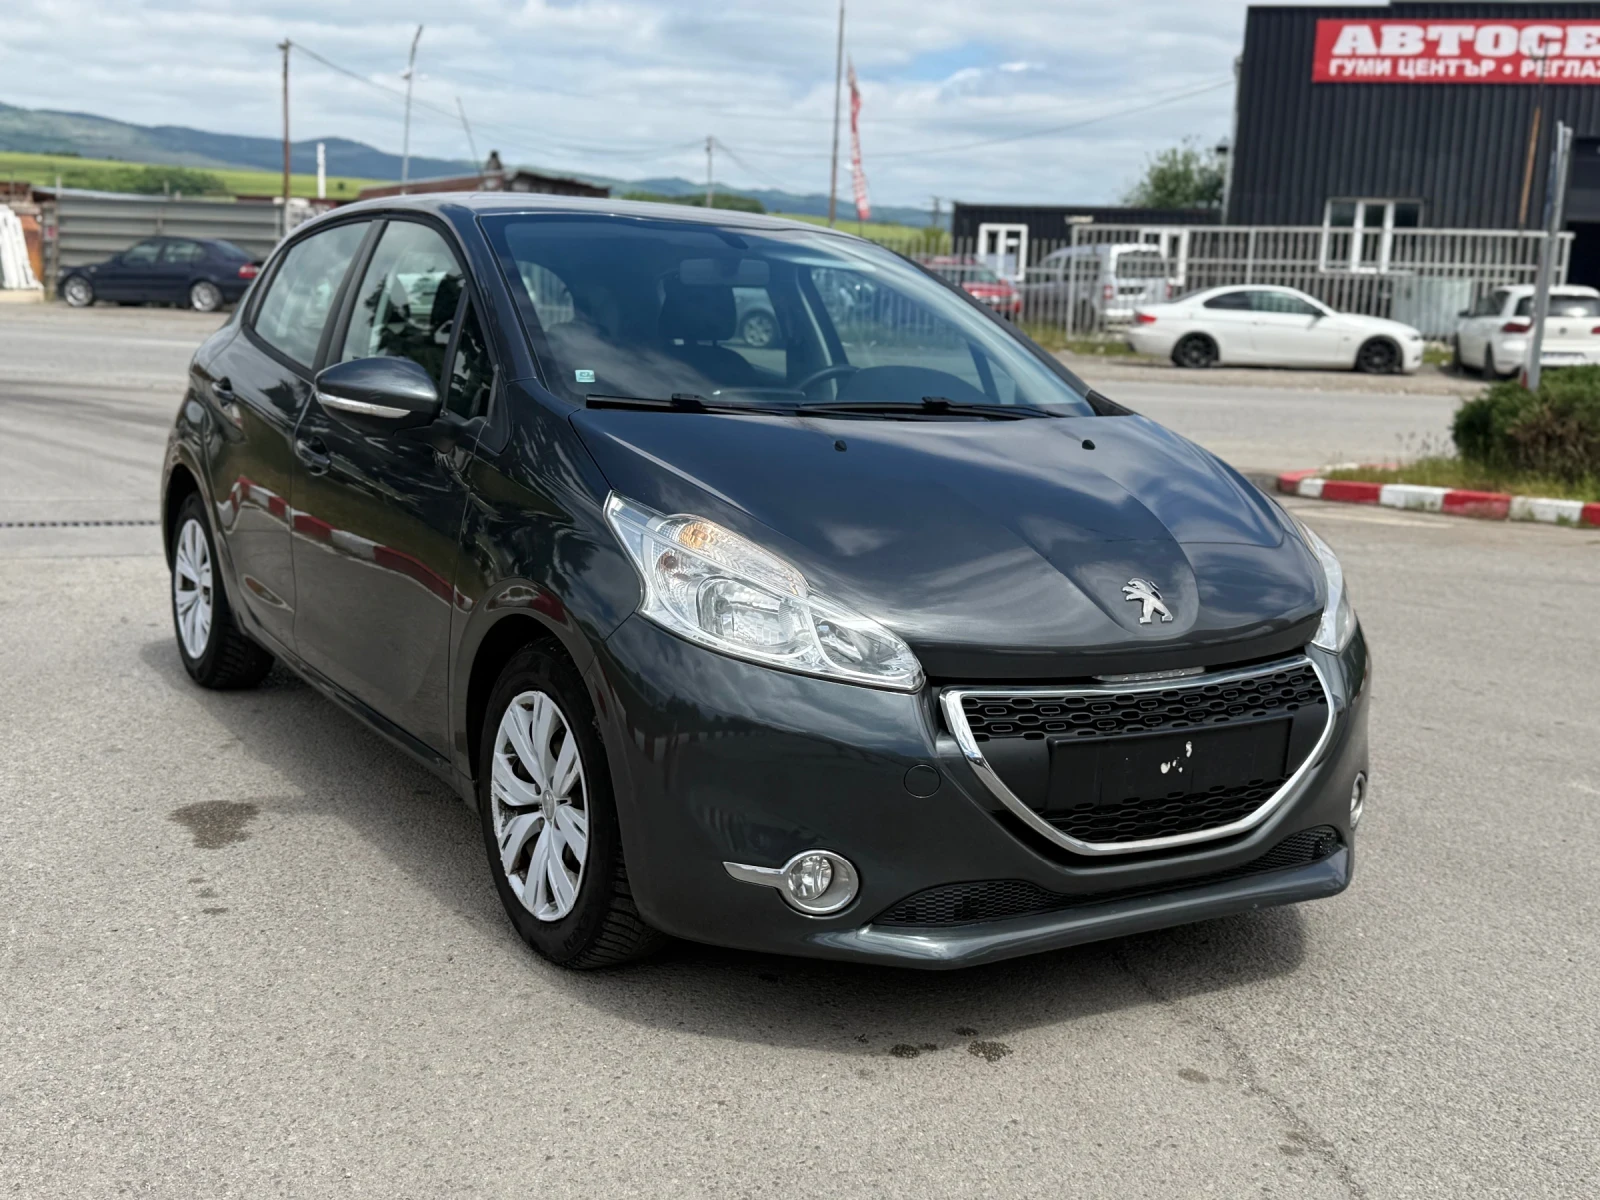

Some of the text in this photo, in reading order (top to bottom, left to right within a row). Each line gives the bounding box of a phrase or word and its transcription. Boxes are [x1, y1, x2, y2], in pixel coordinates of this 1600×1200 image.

[1332, 24, 1600, 57] АВТОСЕ
[1329, 58, 1600, 79] ГУМИ ЦЕНТЪР РЕГЛА
